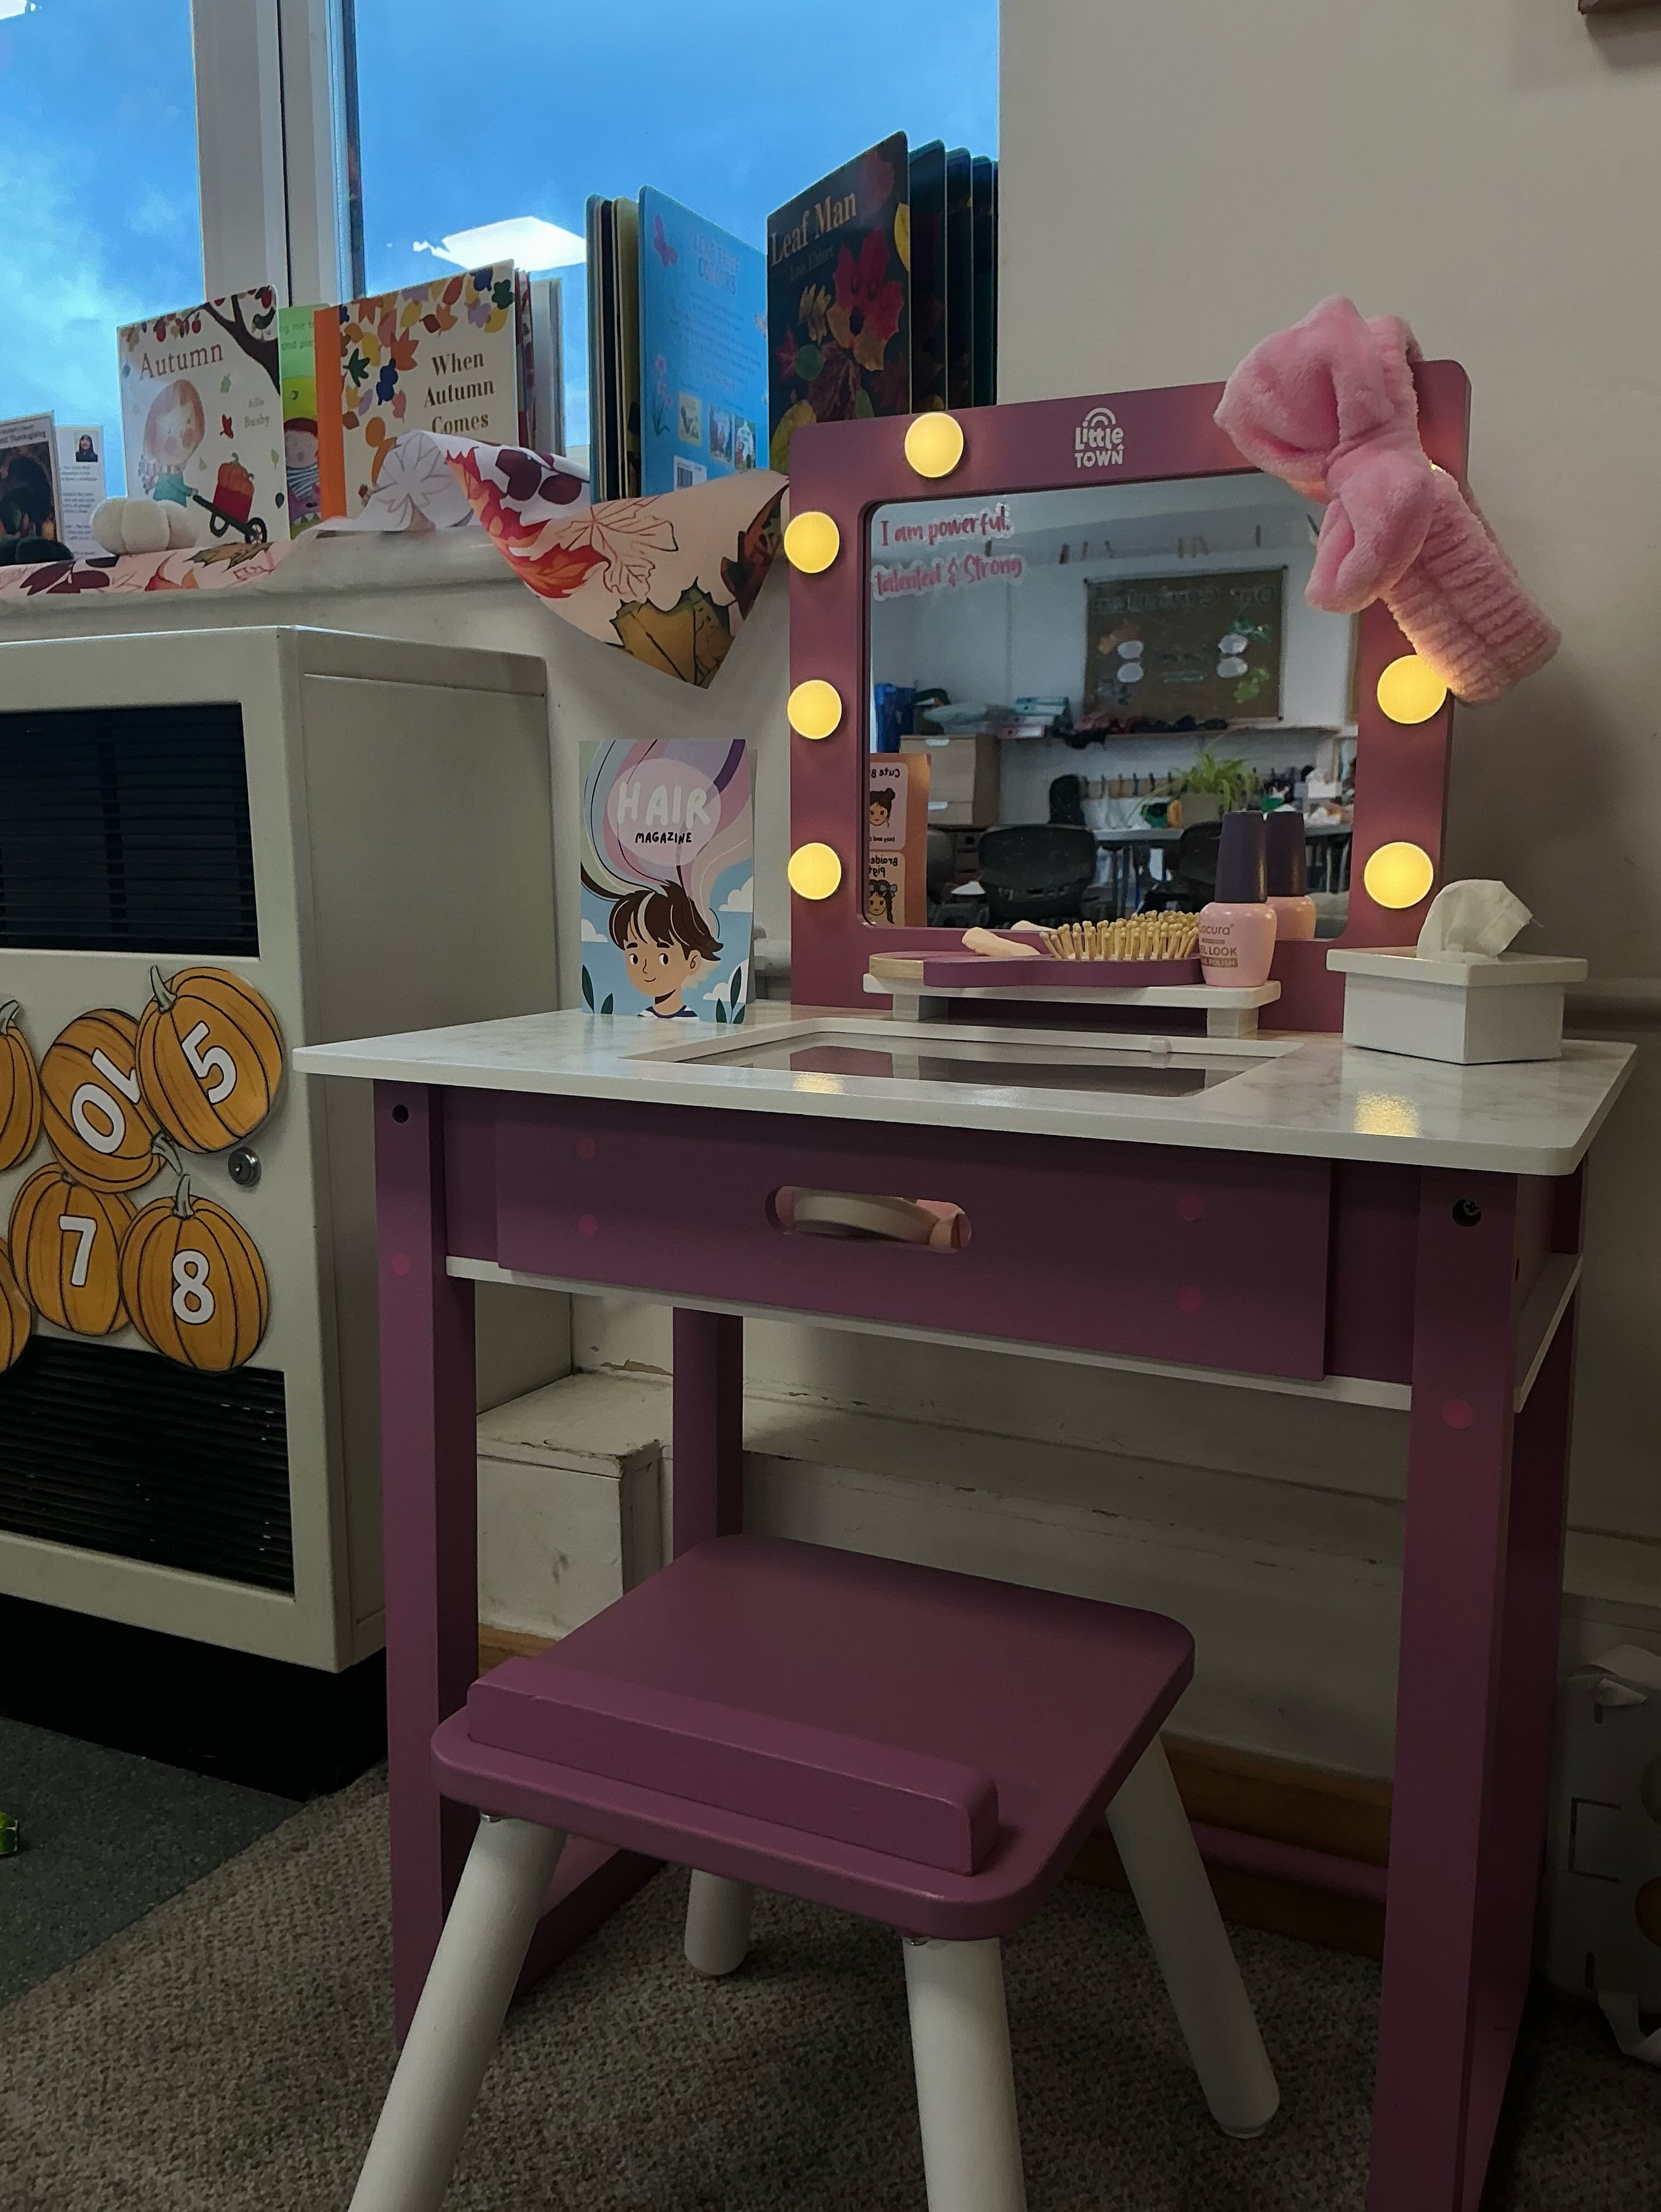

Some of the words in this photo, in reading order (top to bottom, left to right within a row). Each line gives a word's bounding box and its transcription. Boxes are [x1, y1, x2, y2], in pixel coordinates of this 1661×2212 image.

[768, 210, 810, 266] Leaf
[814, 193, 856, 240] Man
[139, 347, 224, 381] Autumn
[431, 353, 484, 376] When
[423, 380, 495, 408] Autumn
[431, 414, 489, 434] Comes
[1075, 421, 1124, 450] Little
[1074, 445, 1124, 468] TOWN
[880, 521, 889, 546] I
[895, 526, 923, 542] am
[617, 781, 710, 829] HAIR
[635, 831, 692, 845] MAGAZINE
[1209, 947, 1238, 956] LOOK
[182, 1020, 237, 1104] 5
[71, 1047, 141, 1154] 10
[59, 1214, 97, 1287] 7
[171, 1250, 215, 1325] 8
